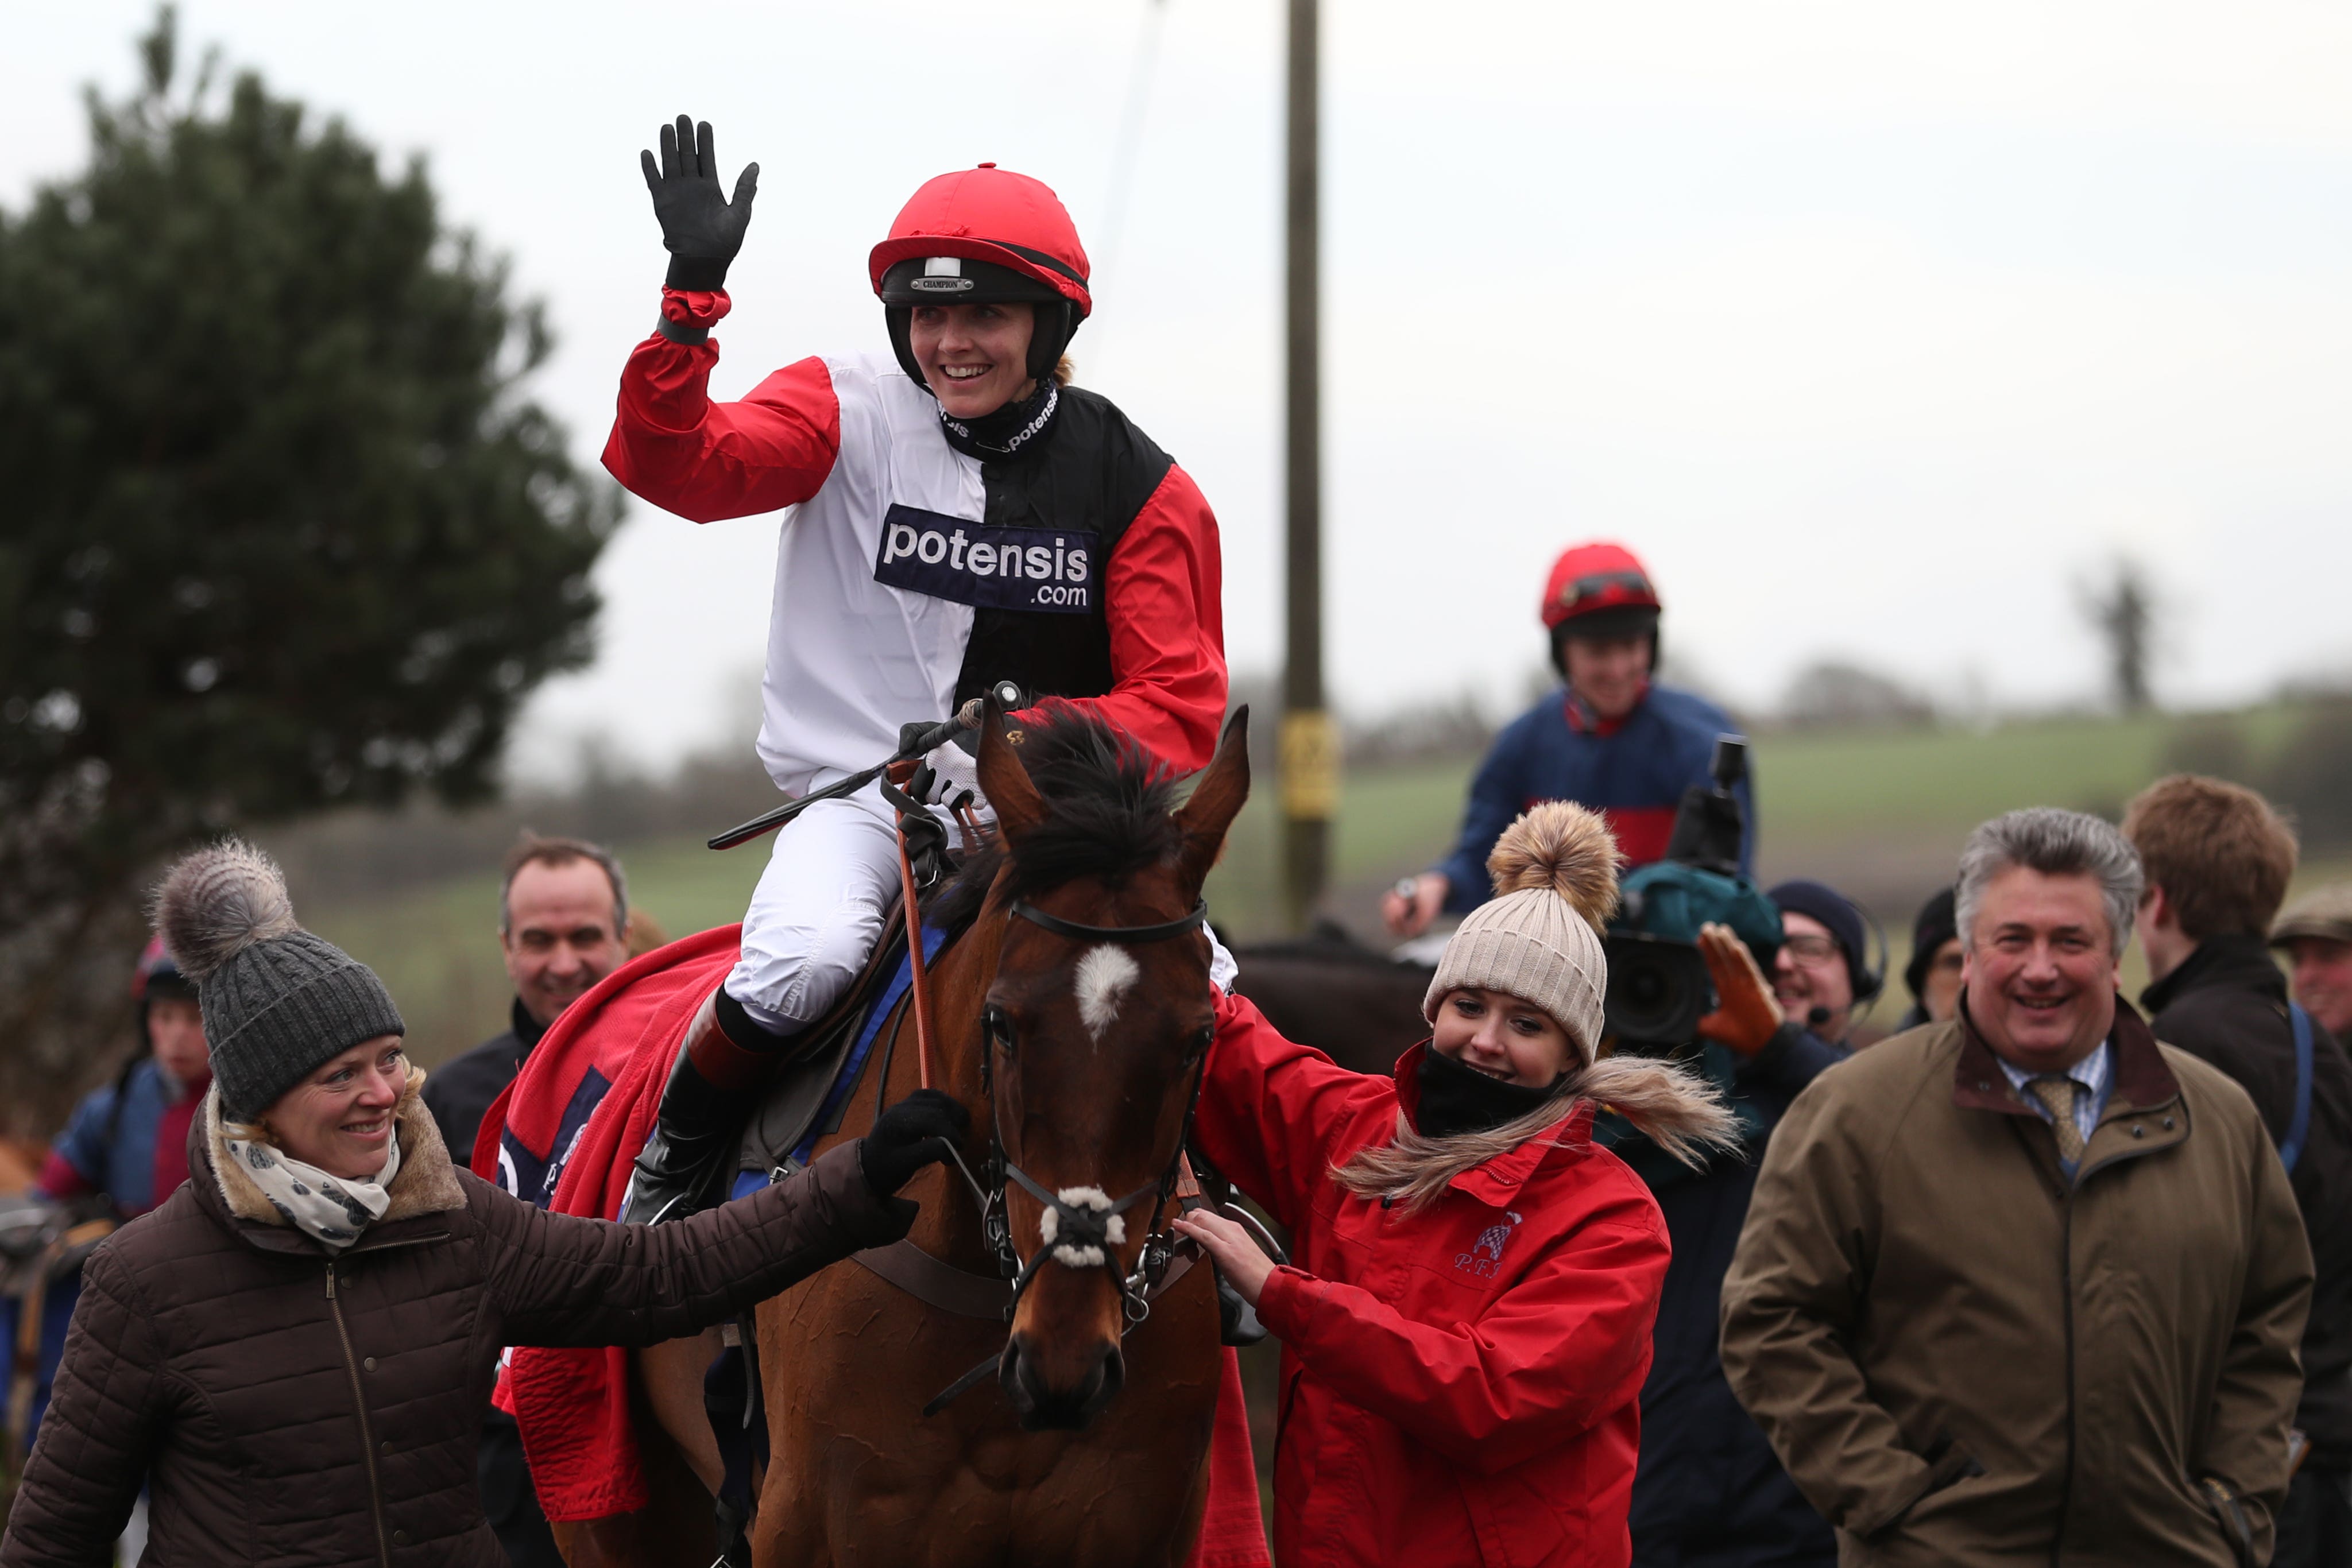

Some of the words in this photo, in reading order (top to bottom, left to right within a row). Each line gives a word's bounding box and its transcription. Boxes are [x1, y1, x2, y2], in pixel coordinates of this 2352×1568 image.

[923, 280, 958, 288] CHAMPION
[1008, 388, 1058, 451] potensis
[883, 523, 1088, 582] potensis
[1031, 585, 1087, 606] .com
